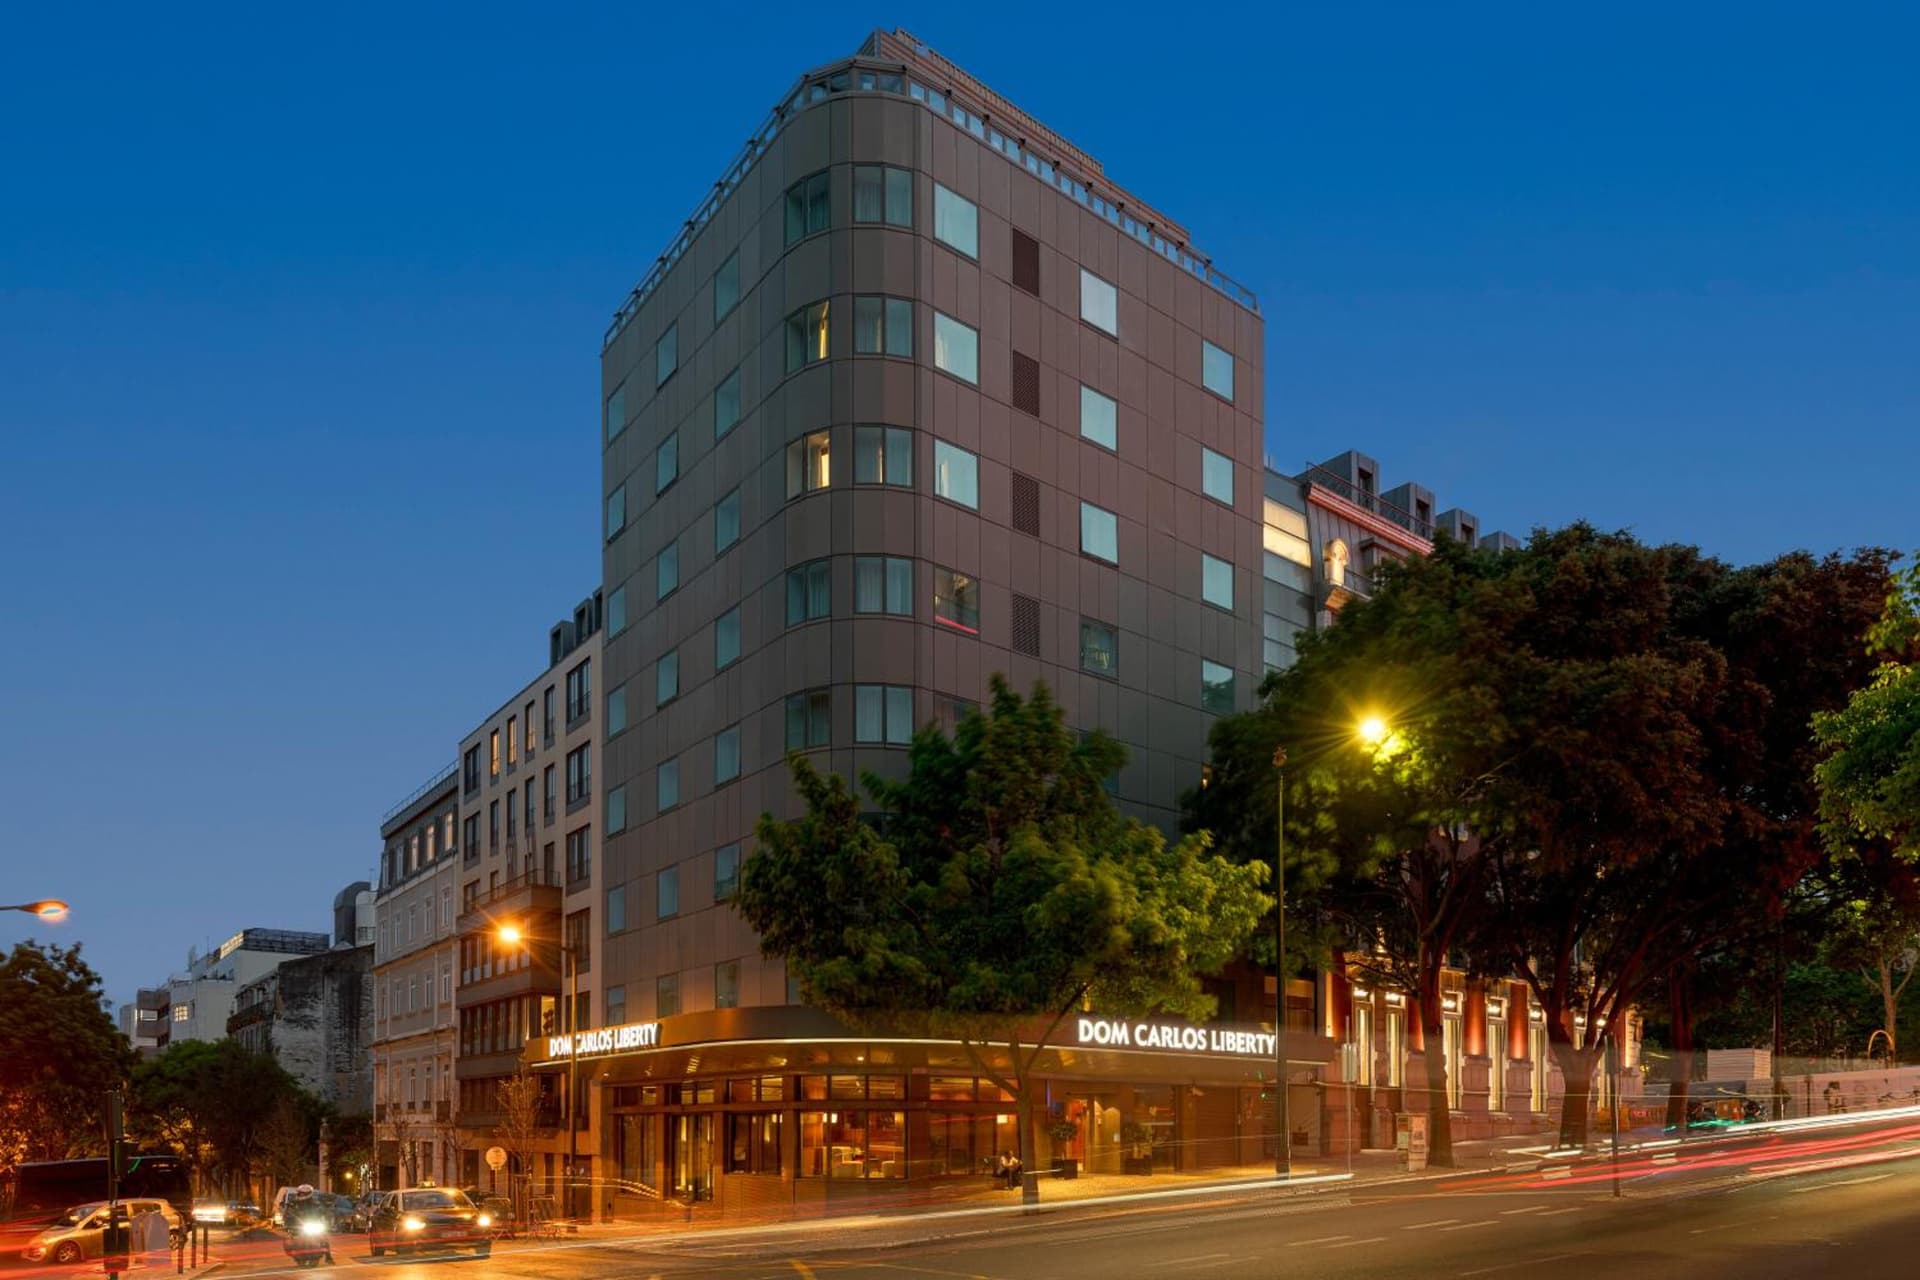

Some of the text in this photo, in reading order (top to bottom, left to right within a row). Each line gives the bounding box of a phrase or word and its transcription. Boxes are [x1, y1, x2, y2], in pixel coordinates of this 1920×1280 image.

[549, 1037, 572, 1057] DOM
[614, 1024, 658, 1049] LIBERTY
[1078, 1019, 1276, 1054] DOM CARLOS LIBERTY
